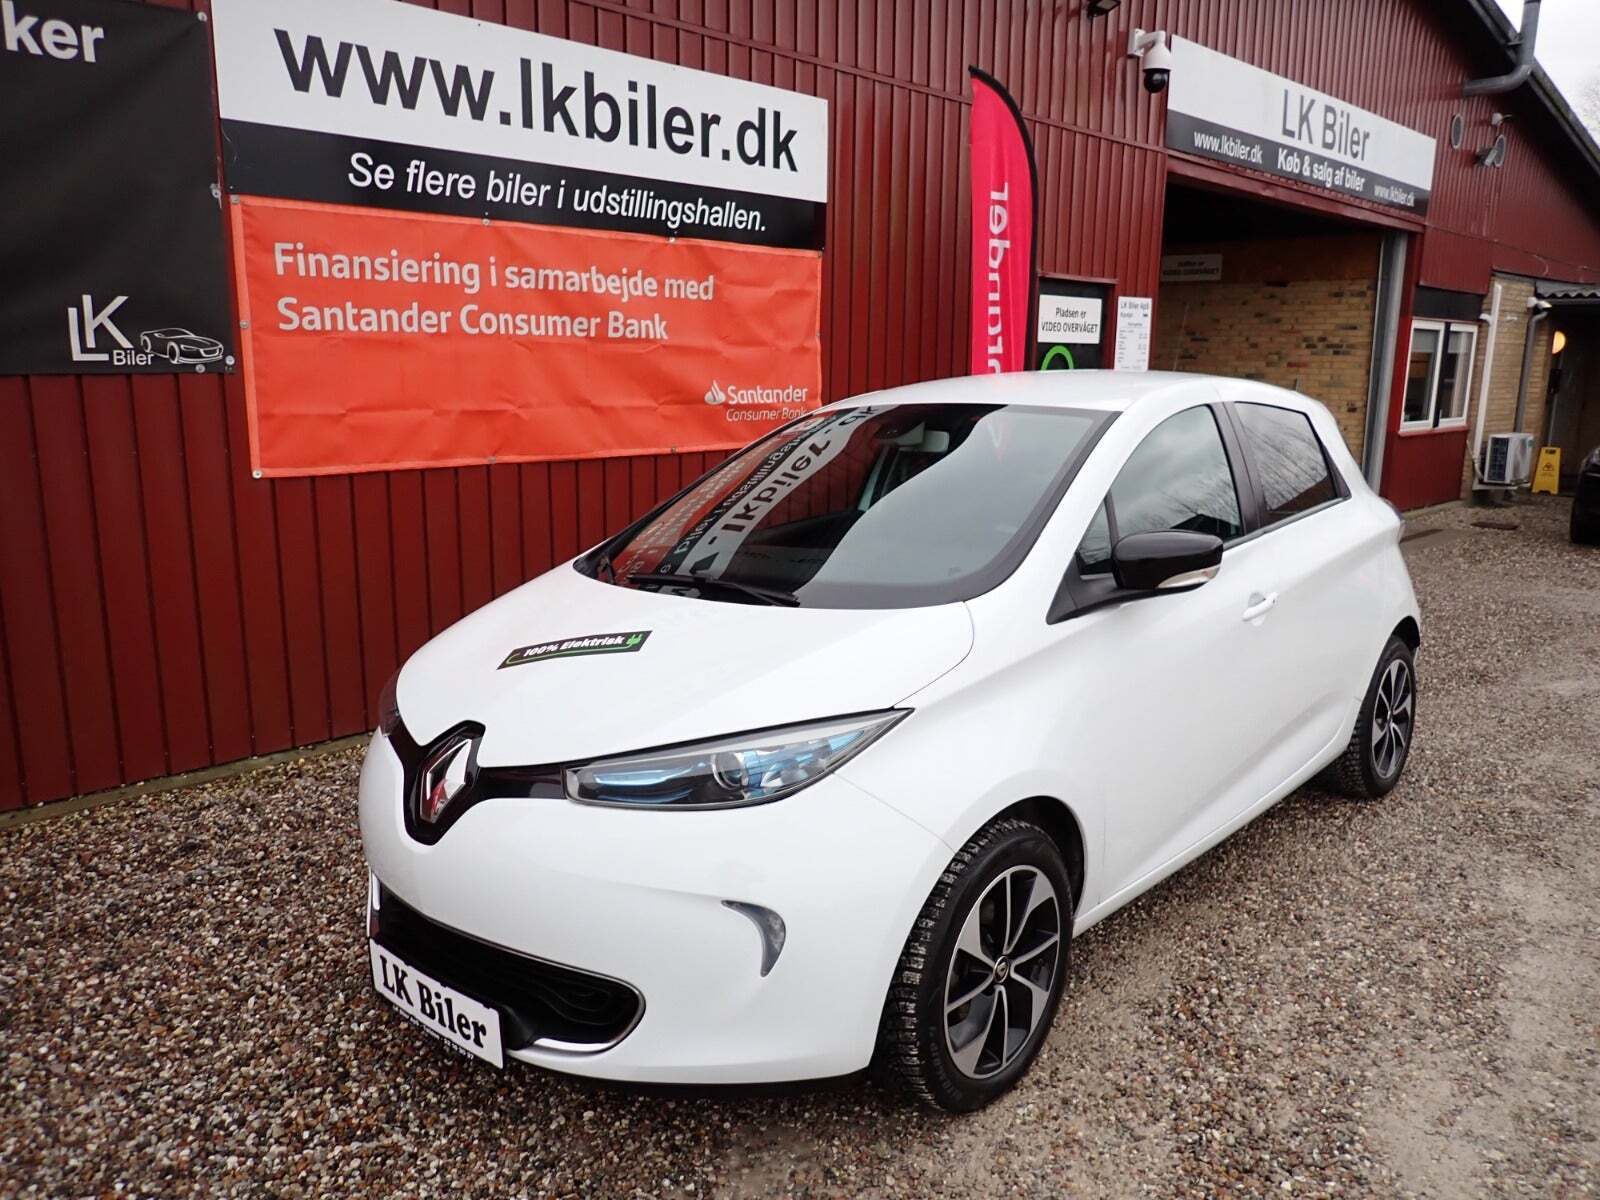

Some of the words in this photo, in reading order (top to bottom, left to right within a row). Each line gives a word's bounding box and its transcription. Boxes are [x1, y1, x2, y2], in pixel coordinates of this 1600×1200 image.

[1, 0, 105, 63] ker
[273, 28, 799, 173] www.lkbiler.dk
[1281, 88, 1316, 145] LK
[1321, 104, 1371, 161] Biler
[1193, 131, 1264, 165] www.lkbiler.dk
[1277, 147, 1301, 174] Køb
[1302, 155, 1312, 177] &
[1312, 161, 1333, 188] salg
[1334, 166, 1345, 186] af
[1345, 168, 1366, 193] biler
[348, 152, 395, 190] Se
[406, 160, 477, 199] flere
[486, 170, 551, 207] biler
[557, 179, 566, 210] i
[573, 185, 767, 231] udstillingshallen.
[274, 242, 481, 294] Finansiering
[489, 255, 498, 287] i
[504, 265, 659, 303] samarbejde
[664, 274, 716, 301] med
[67, 294, 135, 362] LK
[277, 296, 452, 335] Santander
[459, 304, 601, 338] Consumer
[607, 310, 669, 340] Bank
[1041, 321, 1062, 333] VIDEO
[1062, 322, 1099, 334] OVERVÅGET
[1055, 307, 1080, 318] Pladsen
[1080, 311, 1087, 319] er
[112, 350, 155, 366] Biler
[726, 408, 780, 422] Consumer
[727, 385, 809, 405] Santander
[522, 644, 558, 657] 100%
[559, 635, 625, 650] Elektrisk
[380, 954, 414, 1007] LK
[416, 979, 487, 1049] Biler
